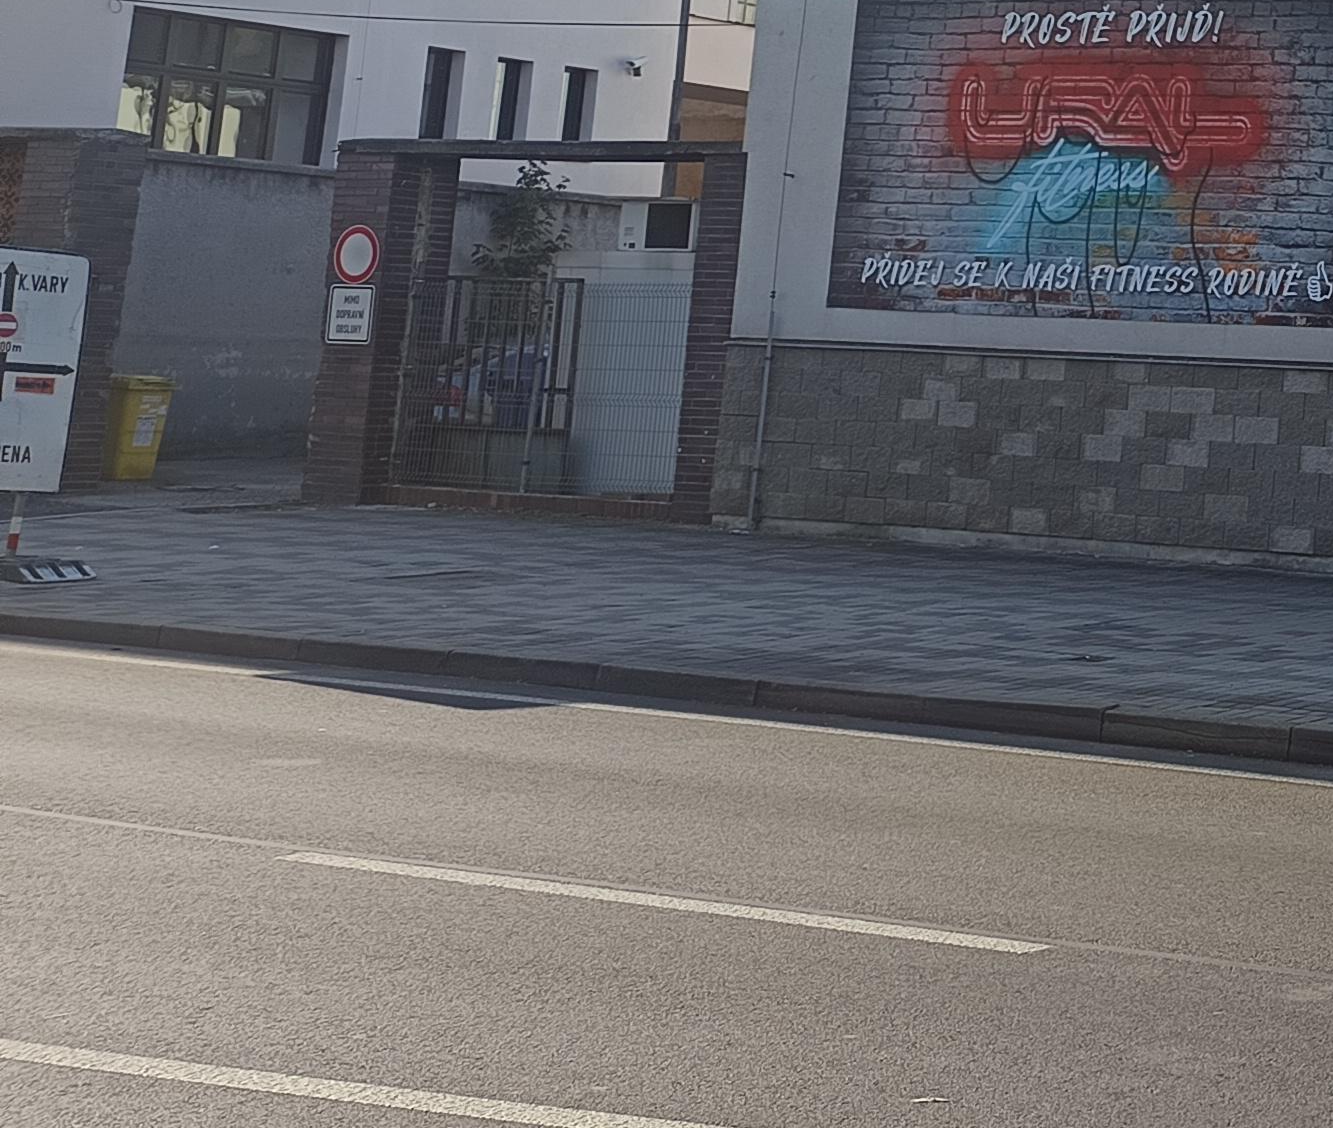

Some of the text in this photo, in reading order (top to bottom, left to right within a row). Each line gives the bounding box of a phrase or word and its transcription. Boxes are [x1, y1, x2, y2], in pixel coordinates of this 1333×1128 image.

[1001, 3, 1224, 48] PROSTĚ PŘIJĎ!
[987, 138, 1160, 248] fitness
[861, 251, 1304, 299] PŘIDEJ SE K NAŠÍ FITNESS RODINĚ
[344, 295, 360, 304] MIMO
[0, 445, 31, 464] ENA
